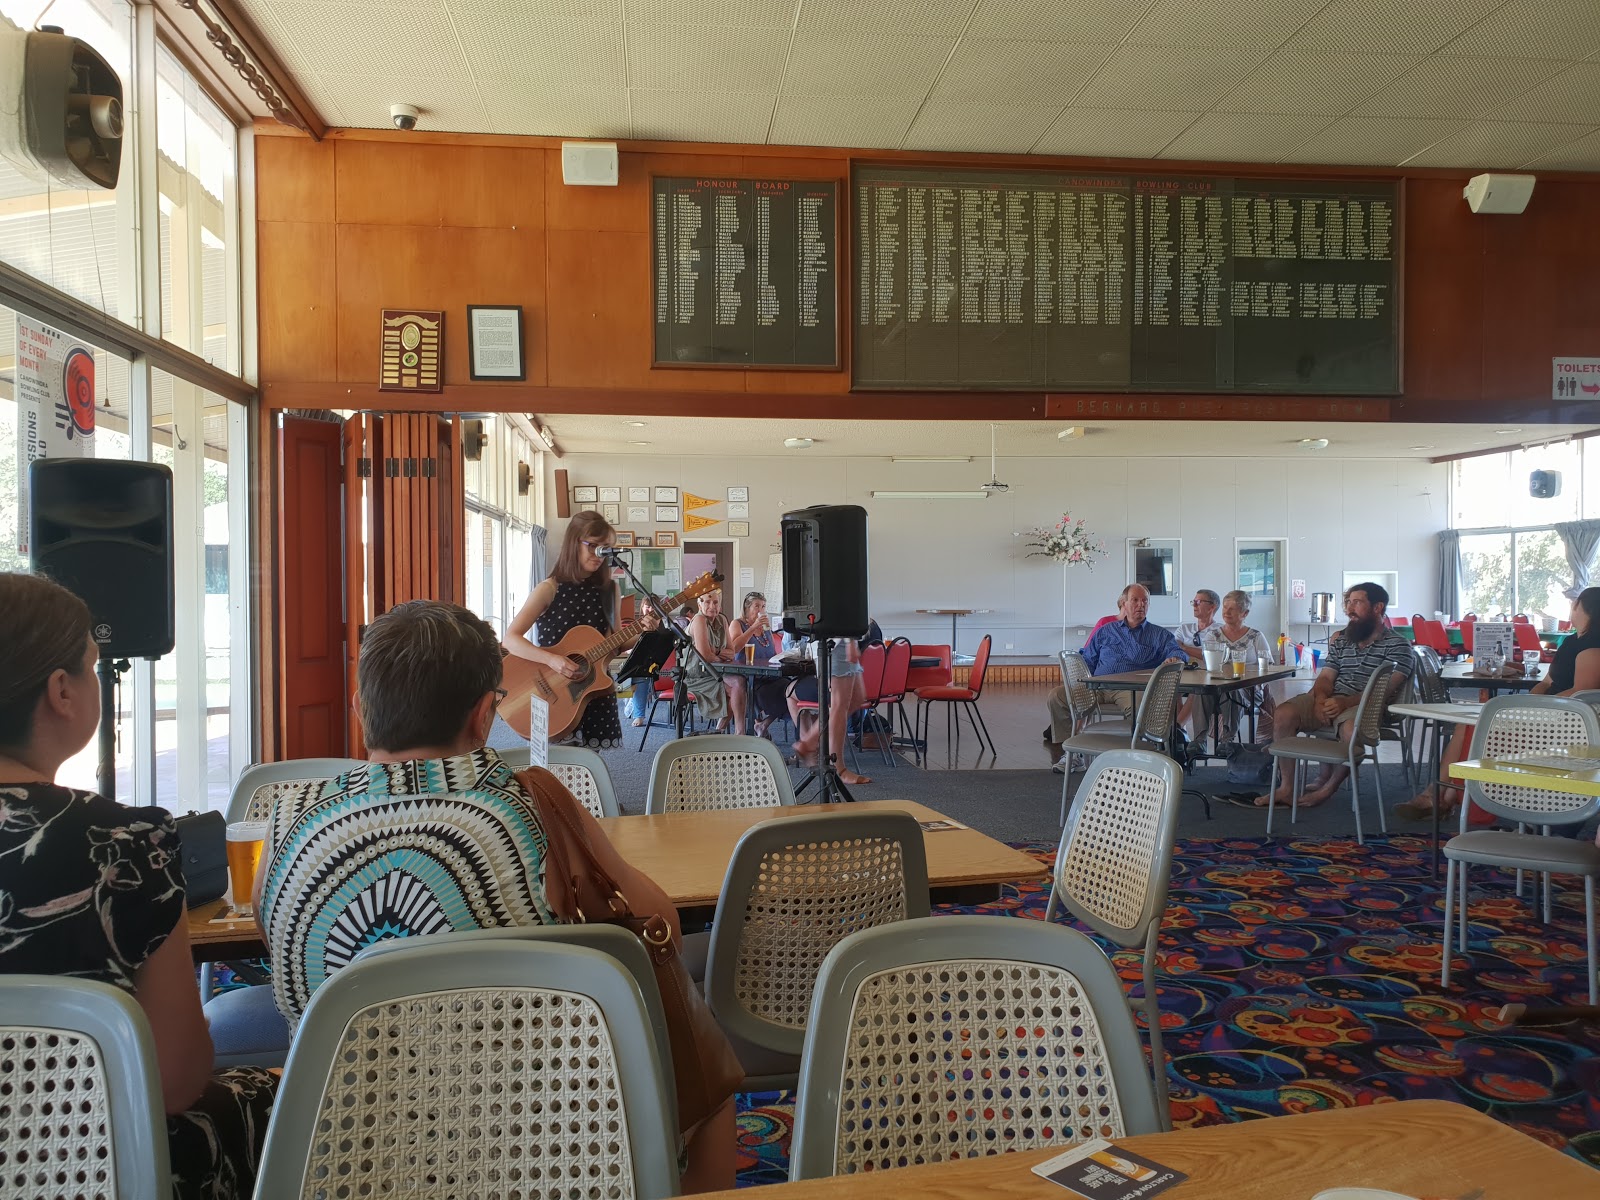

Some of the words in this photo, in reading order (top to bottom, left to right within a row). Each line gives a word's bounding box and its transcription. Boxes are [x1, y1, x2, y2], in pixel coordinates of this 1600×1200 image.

[696, 180, 738, 188] HONOUR
[756, 182, 790, 190] BOARD
[1136, 181, 1180, 190] BOWLING
[19, 323, 28, 336] 1ST
[31, 329, 53, 348] SUNDAY
[19, 340, 26, 351] OF
[28, 344, 48, 361] EVERY
[19, 356, 41, 372] MONTH
[20, 374, 48, 389] CANOWINDRA
[20, 383, 40, 394] BOWLING
[40, 389, 50, 398] CLUB
[20, 393, 41, 403] PRESENTS
[1086, 1180, 1103, 1189] ARE
[1099, 1173, 1119, 1183] TAPS
[1139, 1173, 1174, 1192] CARLTON
